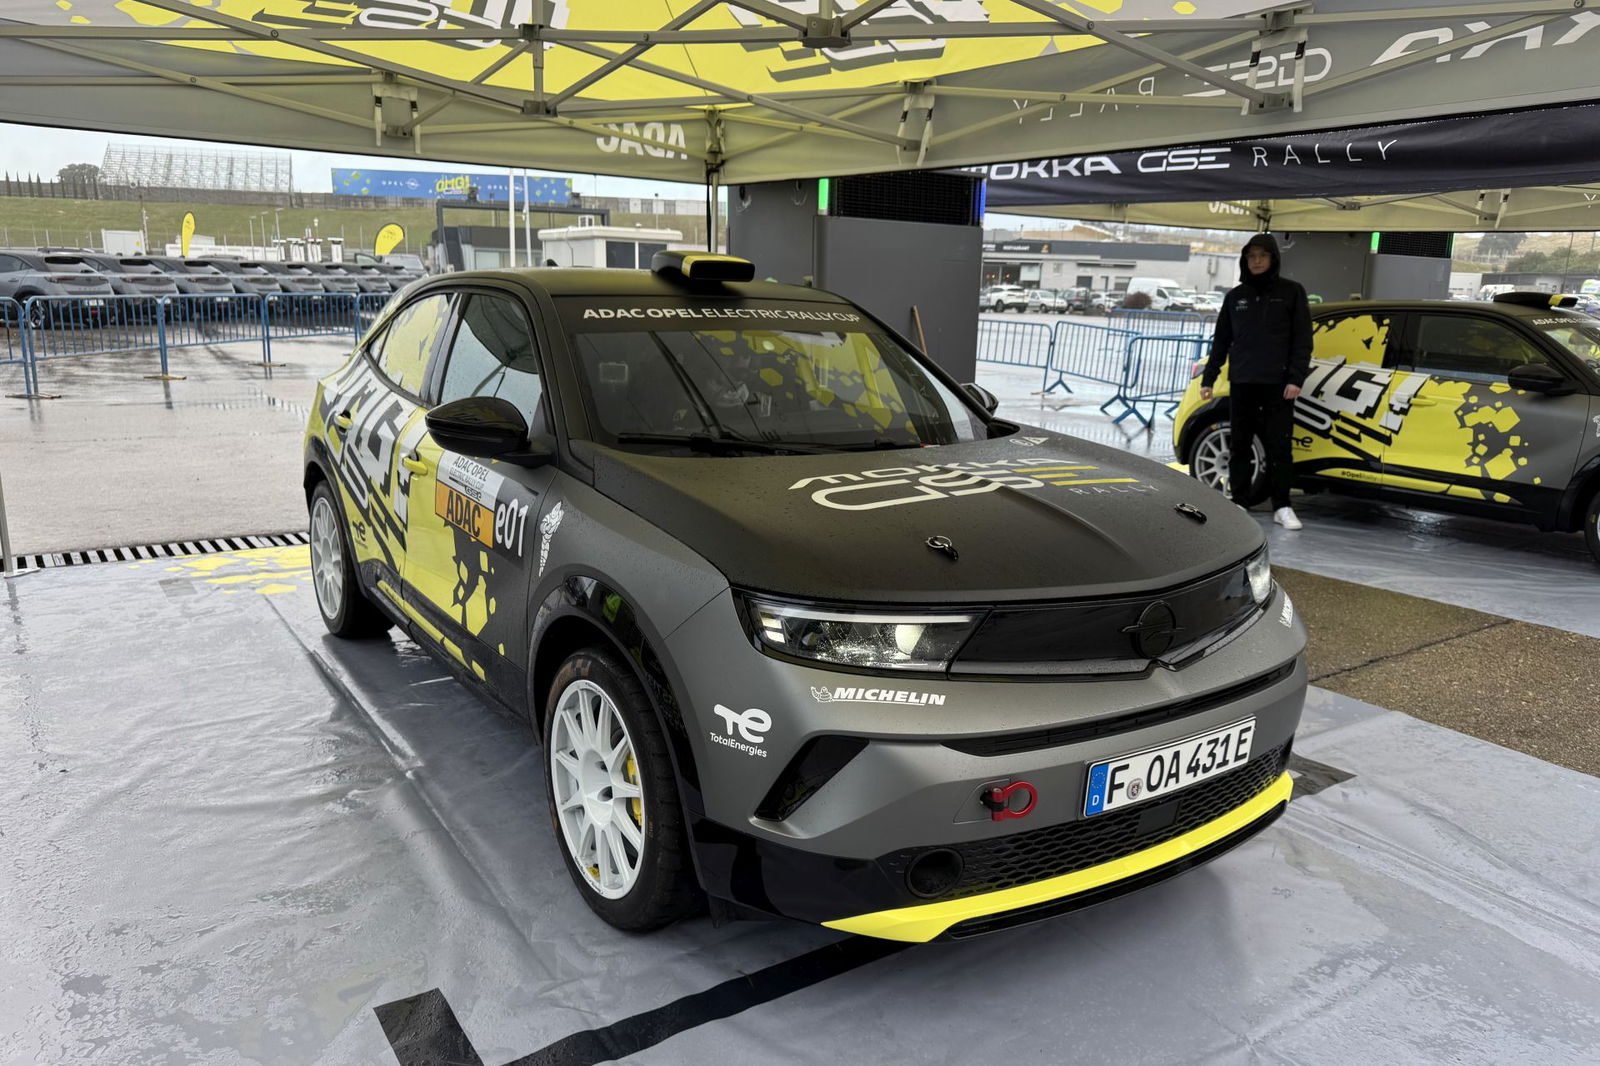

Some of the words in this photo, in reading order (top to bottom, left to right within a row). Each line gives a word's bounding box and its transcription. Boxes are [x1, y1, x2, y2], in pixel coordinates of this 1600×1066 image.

[1137, 147, 1231, 173] GSE
[1252, 139, 1397, 167] RALLY
[583, 308, 645, 319] ADAC
[647, 308, 703, 318] OPEL
[701, 308, 788, 319] ELECTRIC
[786, 310, 834, 321] RALLY
[832, 312, 860, 322] CUP
[453, 456, 474, 473] ADAC
[471, 464, 490, 482] OPEL
[788, 458, 1080, 490] MOKKA
[811, 465, 1139, 511] GSE
[1068, 484, 1160, 495] RALLY
[446, 489, 481, 537] ADAC
[495, 499, 529, 558] e01
[833, 687, 946, 706] MICHELIN
[709, 732, 767, 758] TotalEnergies
[1107, 764, 1130, 804] F
[1146, 750, 1181, 793] OA
[1186, 726, 1252, 778] 431E
[1092, 795, 1099, 806] D
